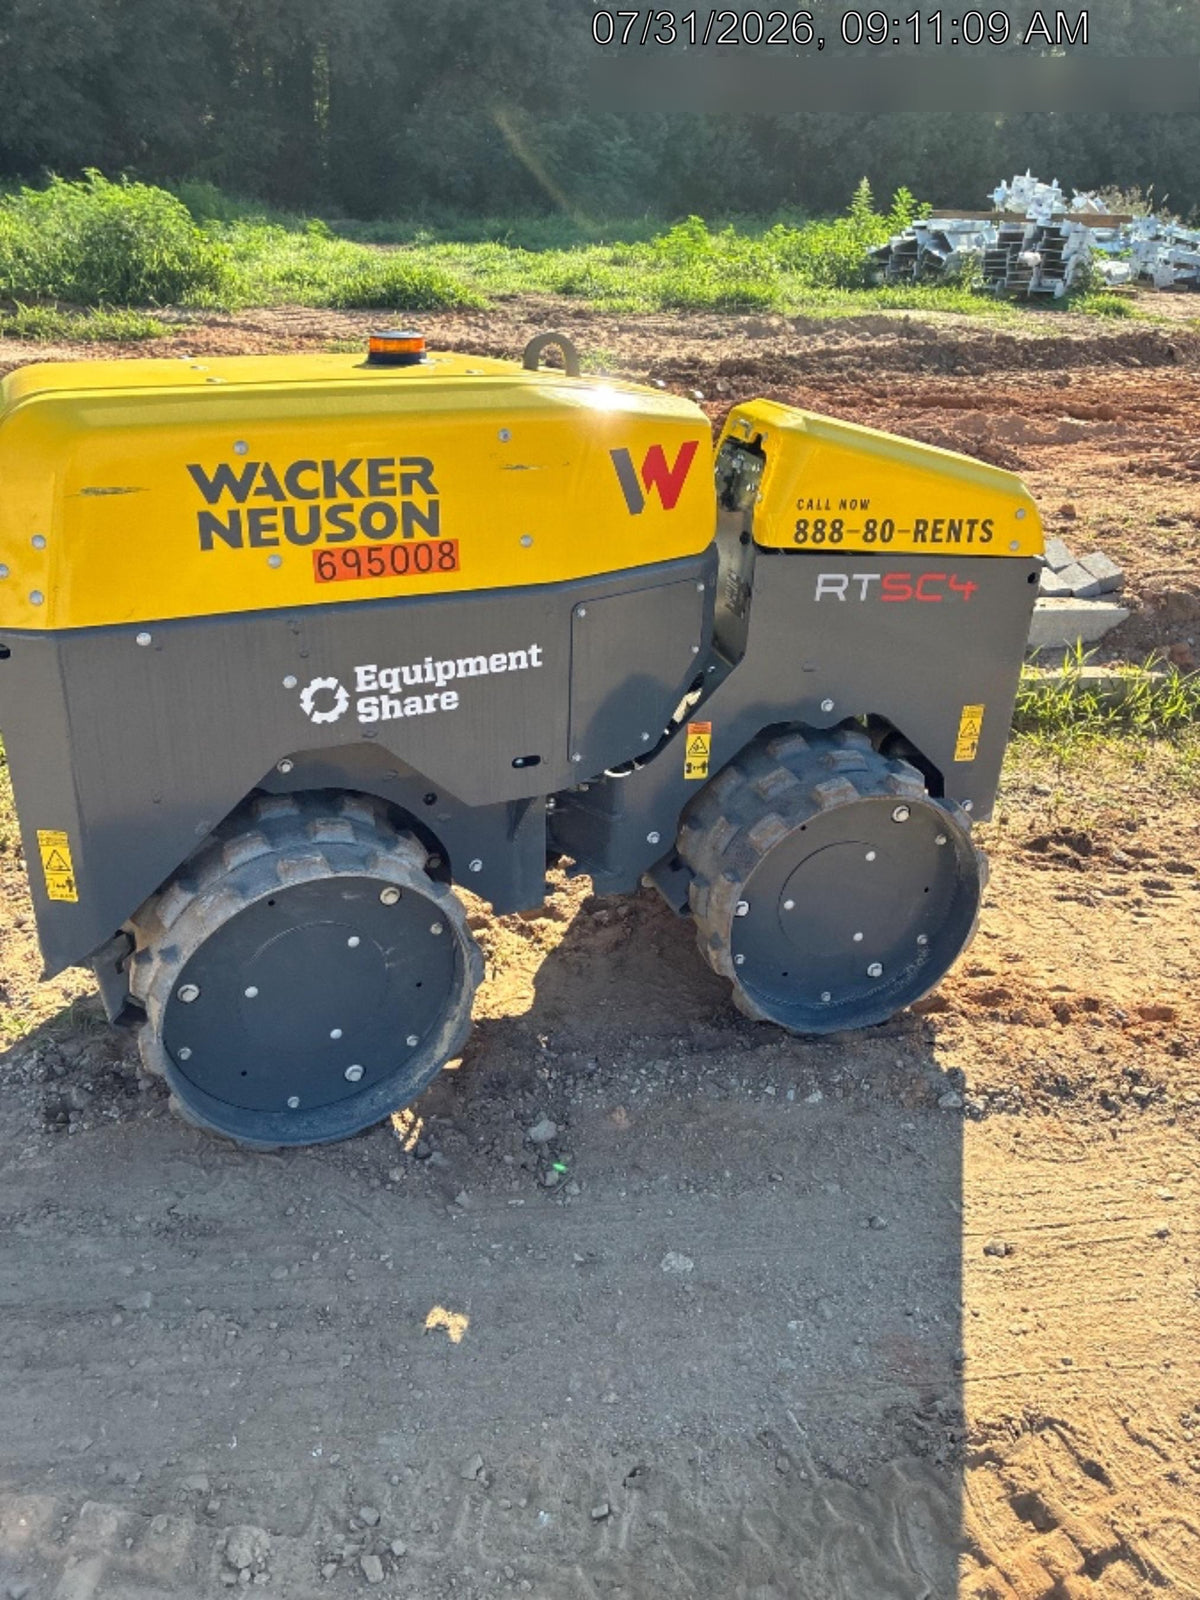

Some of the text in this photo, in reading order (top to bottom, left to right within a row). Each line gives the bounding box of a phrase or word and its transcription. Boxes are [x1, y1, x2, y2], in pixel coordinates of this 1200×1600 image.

[186, 456, 440, 505] WACKER
[197, 499, 441, 551] NEUSON
[796, 498, 871, 511] CALL NOW
[793, 518, 995, 544] 888-80-RENTS
[316, 541, 457, 582] 695008
[354, 643, 543, 694] Equipment
[356, 690, 460, 723] Share
